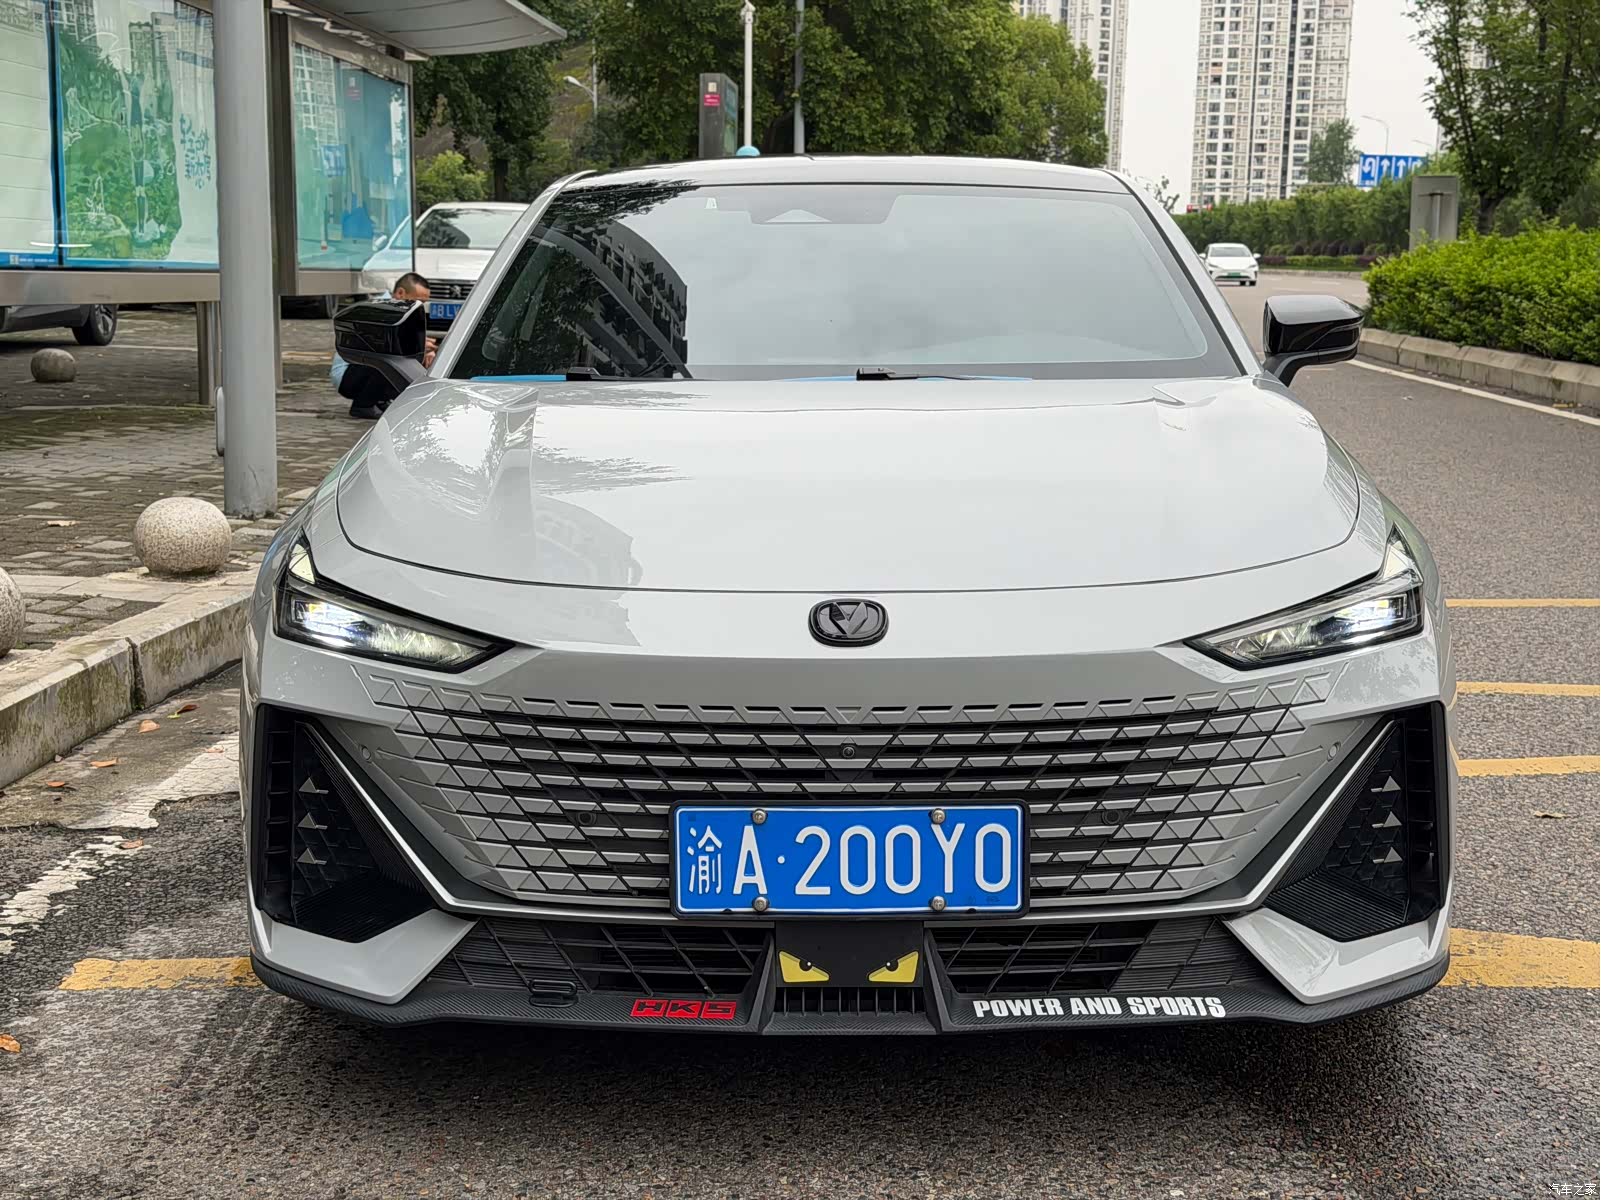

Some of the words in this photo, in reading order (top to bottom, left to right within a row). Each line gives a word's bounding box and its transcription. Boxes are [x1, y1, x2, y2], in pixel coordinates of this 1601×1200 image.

[634, 1000, 733, 1016] HKS
[973, 998, 1064, 1017] POWER
[1070, 996, 1122, 1015] AND
[1126, 996, 1226, 1018] SPORTS
